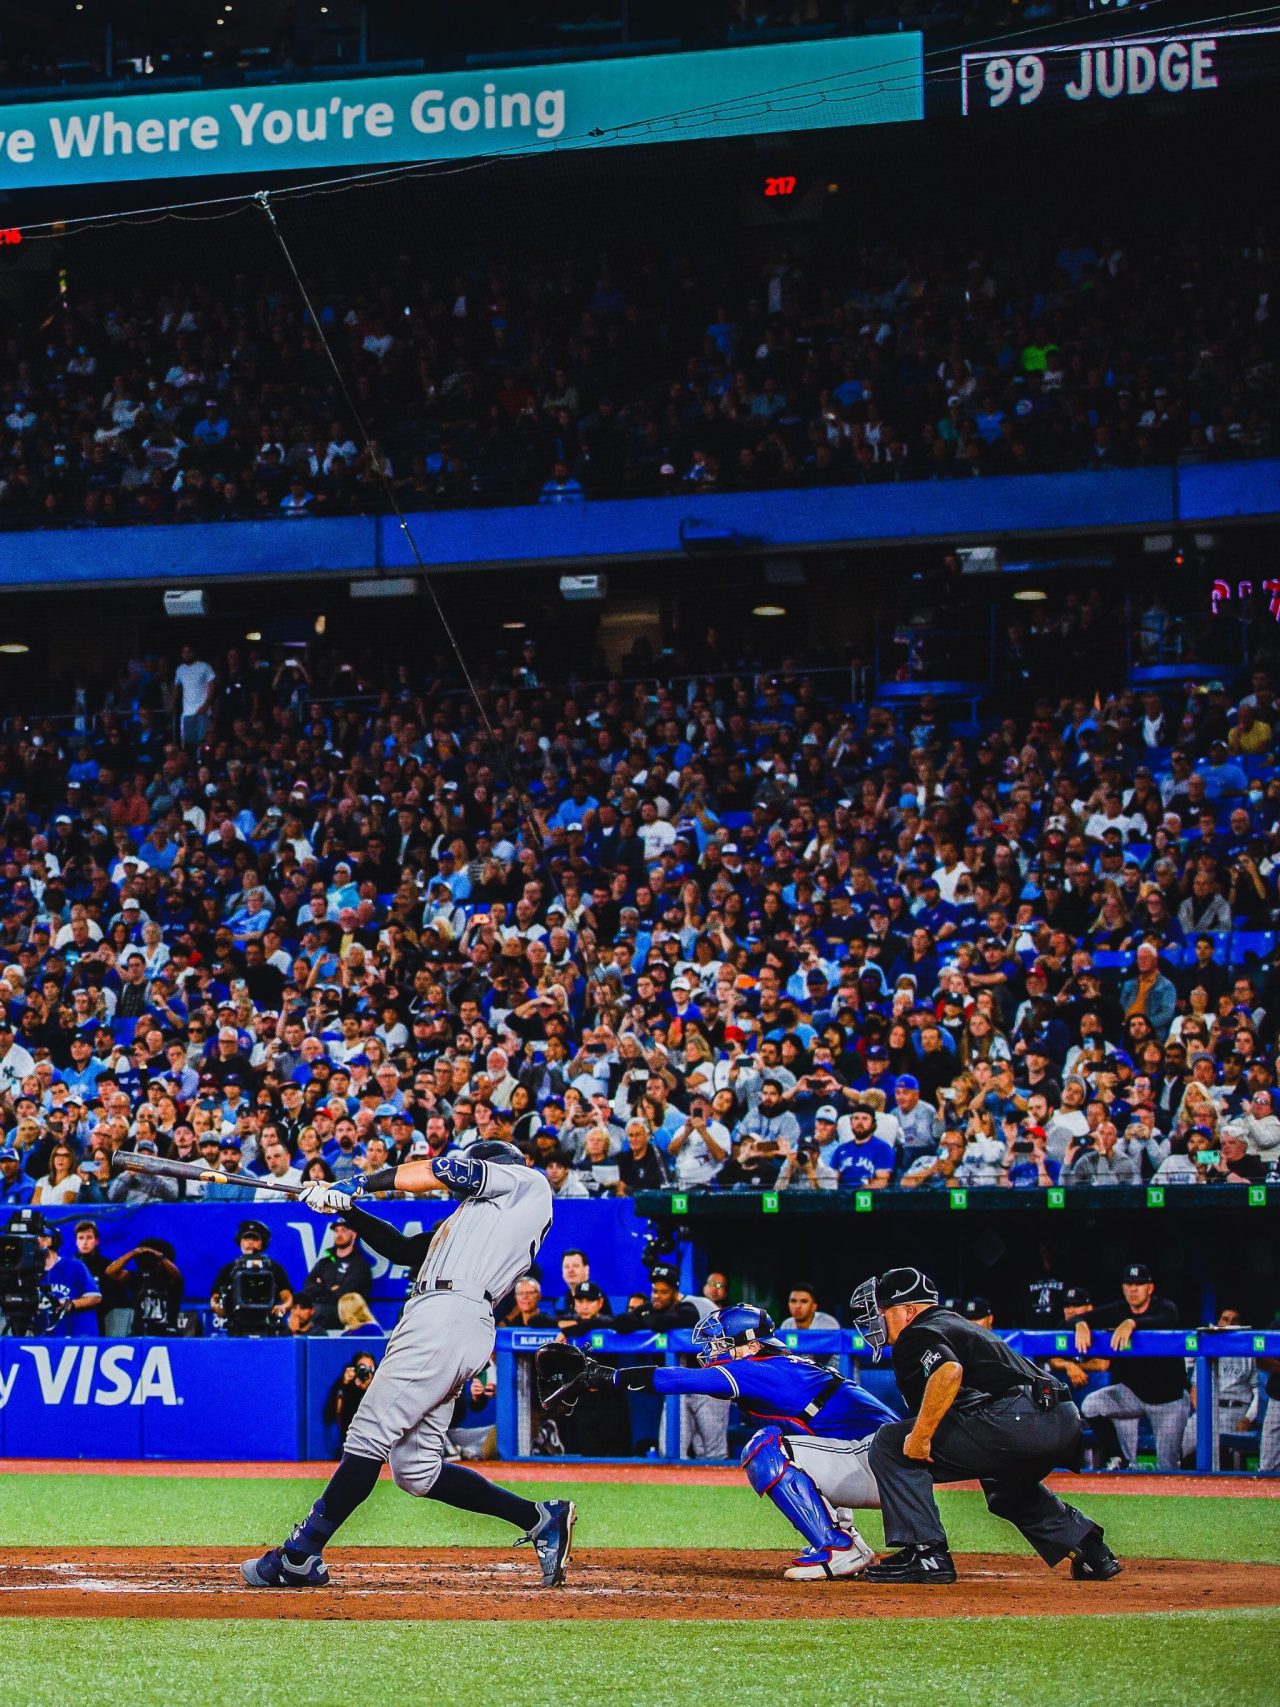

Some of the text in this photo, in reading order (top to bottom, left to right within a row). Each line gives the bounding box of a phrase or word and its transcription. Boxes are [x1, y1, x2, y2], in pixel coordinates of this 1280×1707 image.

[985, 39, 1219, 105] 99 JUDGE
[49, 111, 219, 159] Where
[230, 97, 394, 146] You're
[411, 84, 565, 138] Going
[764, 176, 796, 196] 217
[21, 1345, 177, 1406] VISA
